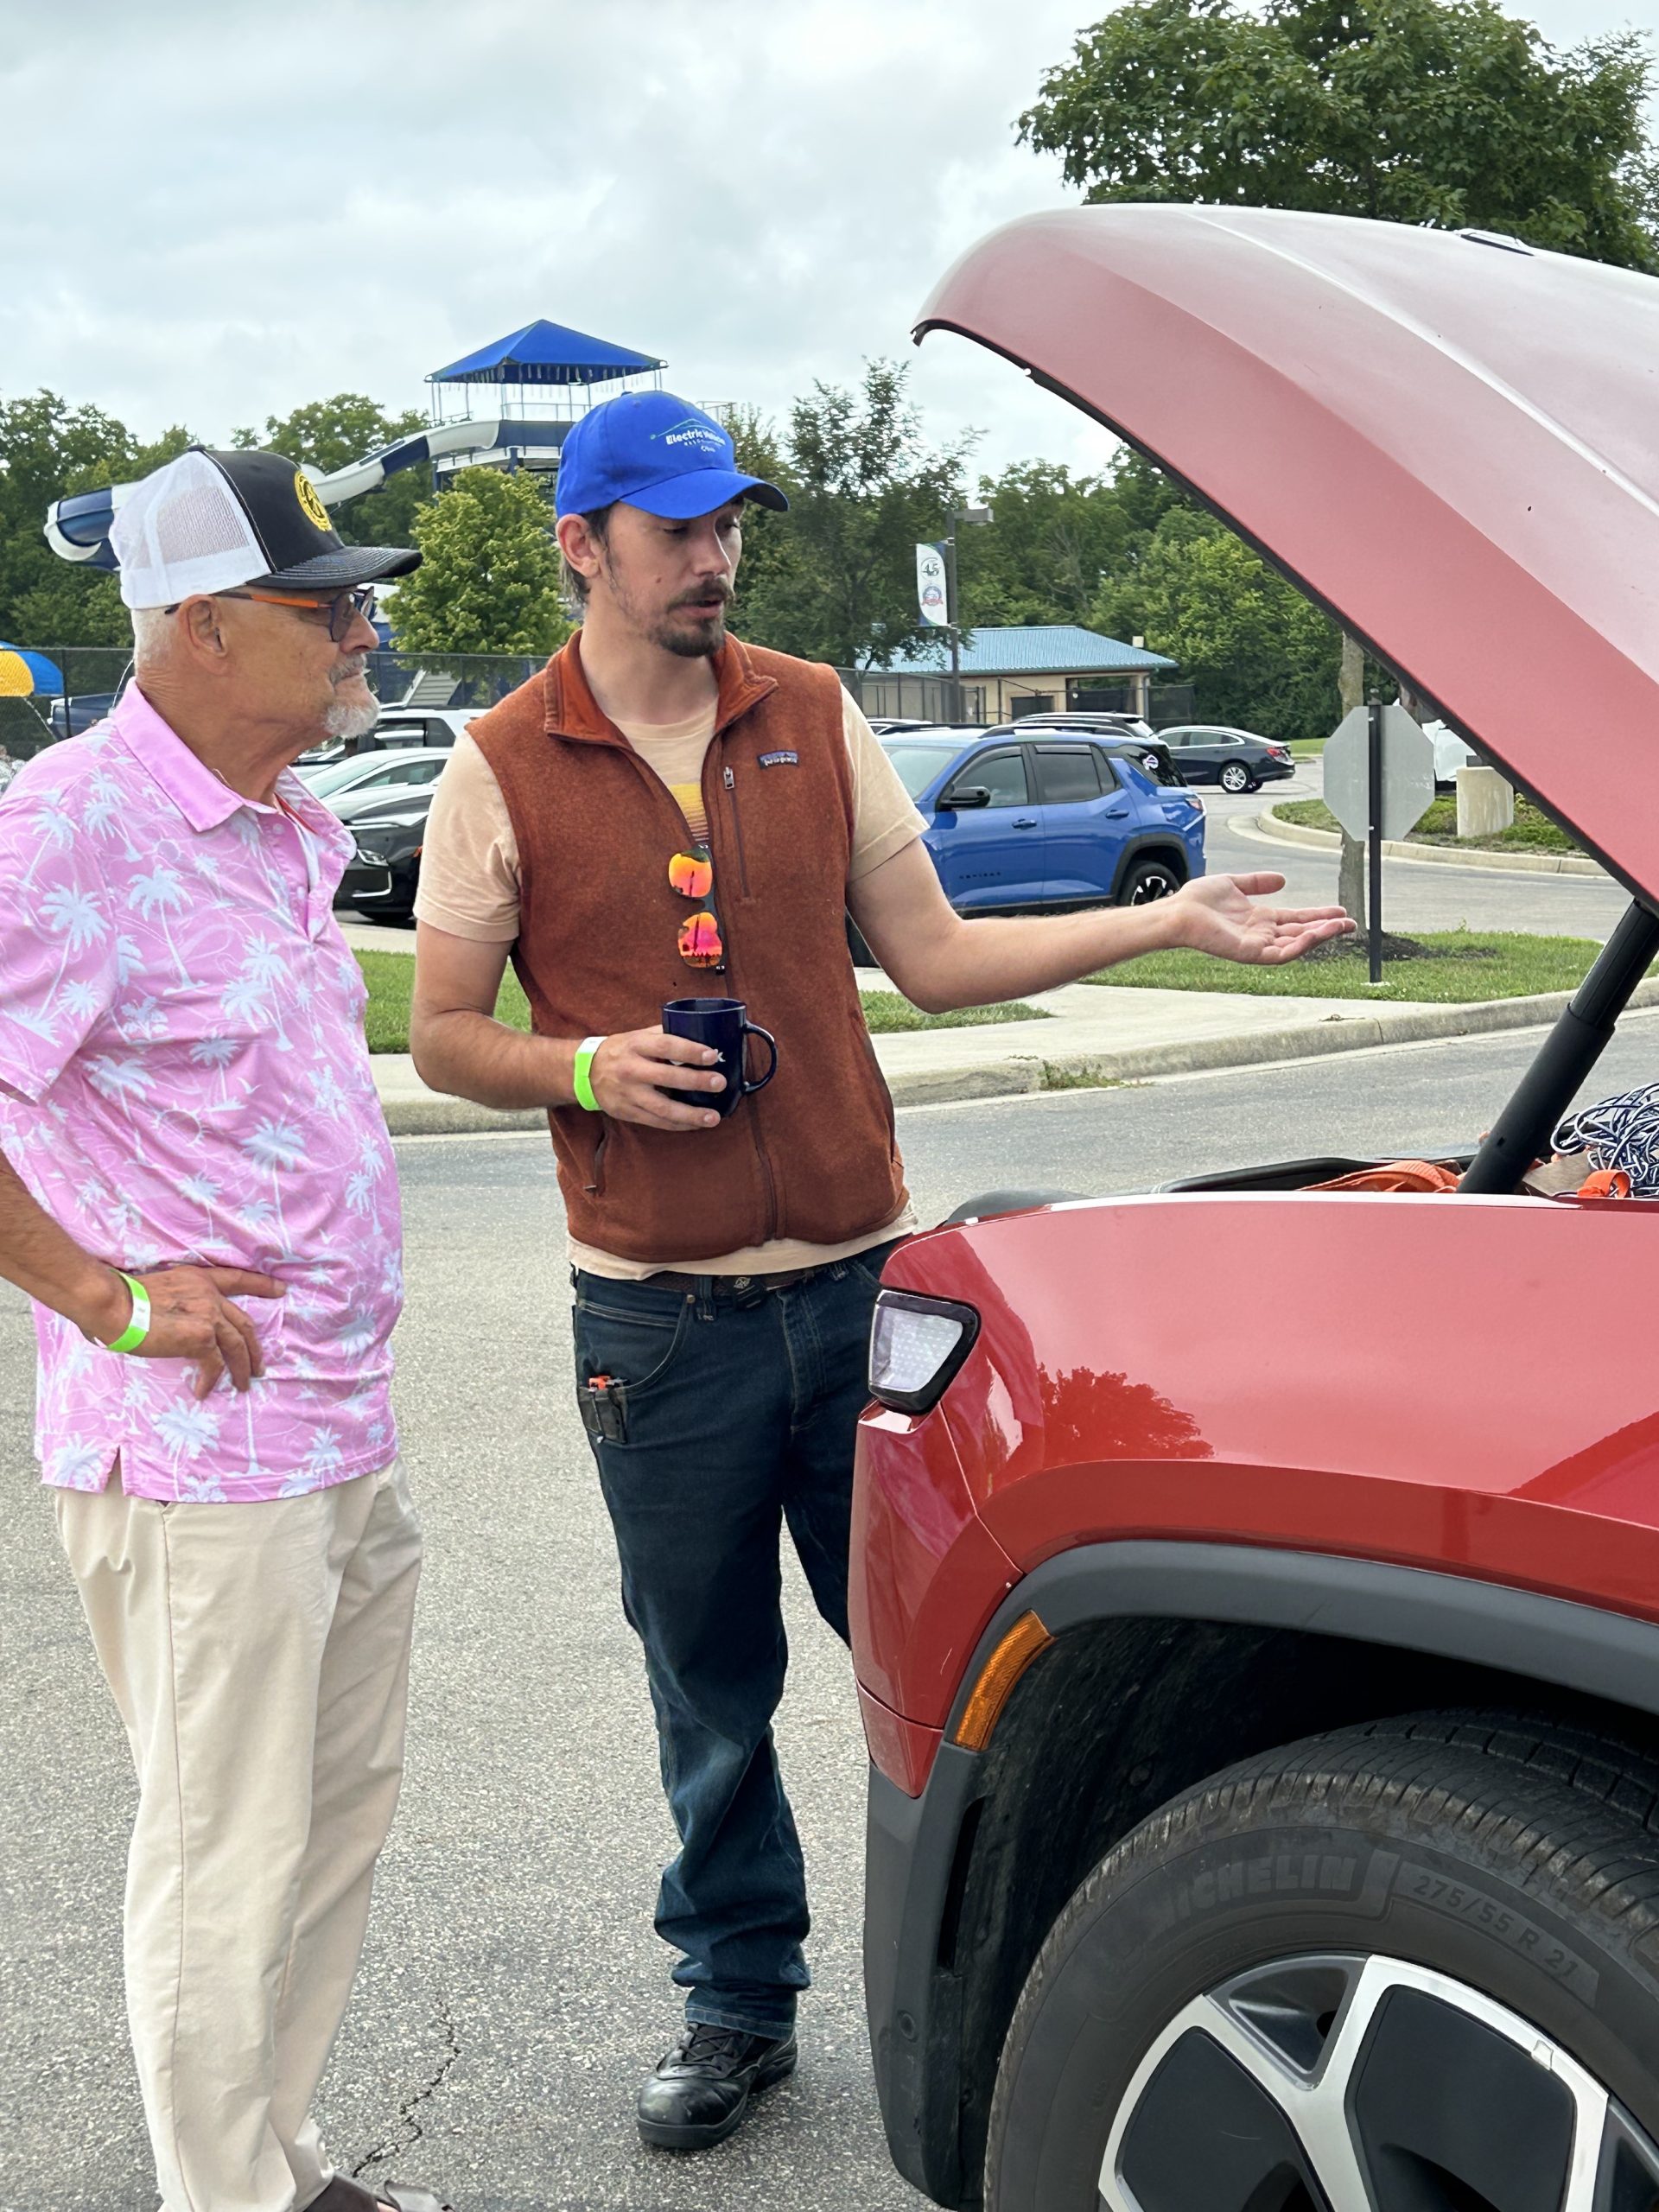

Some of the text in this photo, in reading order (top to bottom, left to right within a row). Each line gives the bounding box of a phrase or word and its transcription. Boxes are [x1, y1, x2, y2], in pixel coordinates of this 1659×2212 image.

[1413, 1875, 1579, 1977] 275/55 R 21
